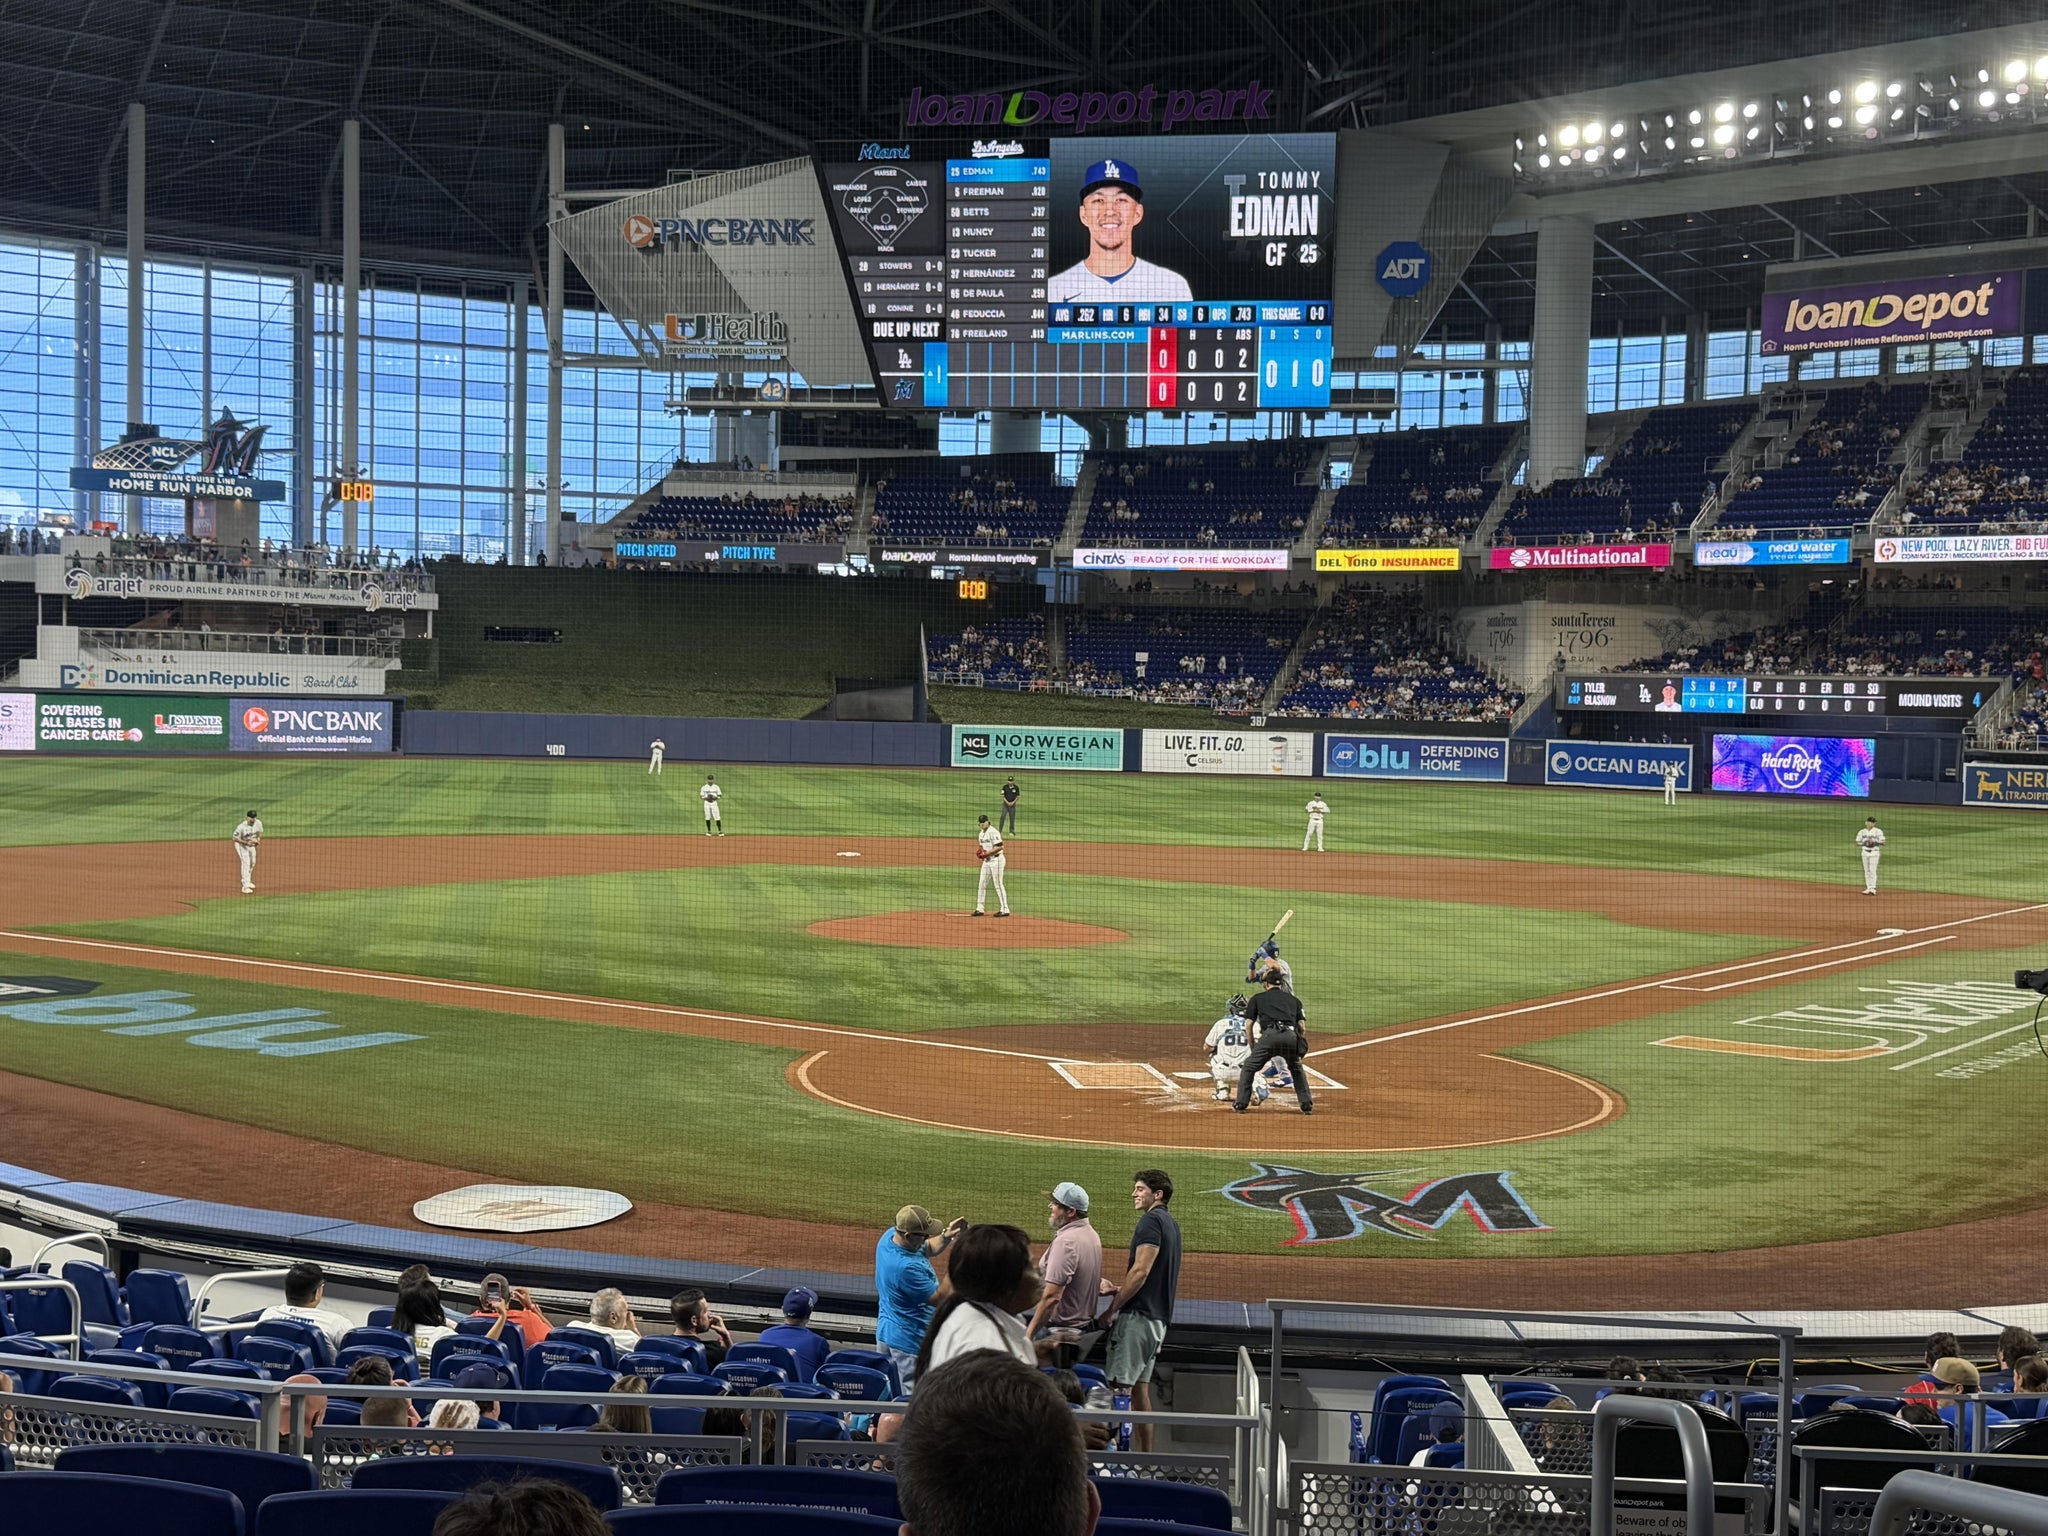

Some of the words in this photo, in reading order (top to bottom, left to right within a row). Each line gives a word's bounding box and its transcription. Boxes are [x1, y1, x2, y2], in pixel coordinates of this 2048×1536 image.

[907, 84, 1158, 133] loanDepot
[1162, 80, 1275, 131] park
[858, 143, 911, 161] Miami
[971, 140, 988, 154] Los
[986, 140, 1025, 159] Angeles
[963, 167, 993, 176] EDMAN
[1258, 171, 1320, 189] TOMMY
[963, 187, 1004, 196] FREEMAN
[963, 208, 990, 216] BETTS
[1230, 194, 1319, 237] EDMAN
[963, 227, 994, 236] MUNCY
[963, 249, 997, 258] TUCKER
[1265, 243, 1287, 266] CF
[1300, 243, 1318, 263] 25
[879, 262, 913, 270] STOWERS
[963, 268, 1016, 278] HERNÁNDEZ
[1382, 258, 1426, 280] ADT
[963, 289, 975, 298] DE
[976, 289, 1005, 298] PAULA
[887, 304, 914, 312] CONINE
[963, 310, 1005, 318] FEDUCCIA
[1055, 309, 1070, 322] AVG
[1123, 308, 1130, 321] 6
[1159, 308, 1169, 320] 34
[1198, 308, 1204, 321] 6
[1212, 308, 1227, 321] OPS
[1235, 307, 1251, 321] .743
[1262, 307, 1278, 321] THIS
[1279, 307, 1301, 321] GAME:
[1784, 282, 1995, 333] loanDepot
[873, 322, 895, 337] DUE
[896, 322, 911, 337] UP
[912, 322, 940, 337] NEXT
[963, 329, 1008, 338] FREELAND
[1062, 331, 1135, 340] MARLINS.COM
[1235, 329, 1251, 340] ABS
[1784, 342, 1808, 351] Home
[1809, 339, 1850, 350] Purchase
[1854, 336, 1880, 345] Home
[1881, 333, 1926, 344] Refinance
[1929, 328, 1993, 340] loanDepot.com
[665, 347, 701, 355] UNIVERSITY
[702, 347, 710, 355] OF
[711, 347, 733, 355] MIAMI
[734, 347, 758, 355] HEALTH
[759, 347, 784, 355] SYSTEM
[898, 348, 912, 369] LA
[1159, 349, 1168, 369] 0
[1188, 349, 1197, 370] 0
[1215, 349, 1224, 369] 0
[1238, 348, 1247, 368] 2
[1266, 360, 1278, 388] 0
[1292, 360, 1299, 388] 1
[1312, 359, 1324, 387] 0
[763, 382, 782, 397] 42
[1159, 382, 1168, 402] 0
[1187, 382, 1197, 402] 0
[1214, 382, 1223, 401] 0
[1238, 381, 1246, 401] 2
[151, 446, 178, 458] NCL
[129, 472, 184, 481] NORWEGIAN
[185, 475, 215, 483] CRUISE
[217, 477, 236, 485] LINE
[109, 478, 154, 492] HOME
[159, 481, 193, 494] RUN
[196, 483, 252, 497] HARBOR
[341, 482, 372, 502] 0:08
[616, 543, 644, 557] PITCH
[646, 543, 677, 558] SPEED
[723, 546, 750, 559] PITCH
[752, 547, 776, 560] TYPE
[1801, 542, 1838, 552] water
[1901, 540, 1922, 552] NEW
[1925, 540, 1951, 551] POOL.
[1954, 540, 1979, 551] LAZY
[2015, 539, 2031, 550] BIG
[881, 550, 937, 563] loanDepot
[949, 553, 969, 562] Home
[996, 554, 1037, 565] Everything
[1133, 556, 1169, 564] READY
[1173, 556, 1194, 564] FOR
[1199, 556, 1219, 564] THE
[1222, 556, 1276, 565] WORKDAY
[1320, 558, 1342, 567] DEL
[1344, 554, 1378, 567] TORO
[1382, 557, 1455, 567] INSURANCE
[1533, 547, 1647, 566] Multinational
[95, 574, 144, 599] arajet
[150, 584, 182, 593] PROUD
[186, 587, 223, 595] AIRLINE
[226, 588, 268, 597] PARTNER
[284, 591, 300, 599] THE
[383, 589, 418, 612] arajet
[960, 580, 986, 600] 0:08
[1488, 628, 1514, 652] 1796
[1558, 628, 1609, 653] 1796
[105, 669, 207, 686] Dominican
[211, 671, 290, 689] Republic
[303, 675, 334, 688] Beach
[336, 676, 358, 687] Club
[1584, 683, 1605, 693] TYLER
[1639, 684, 1651, 703] LA
[1821, 683, 1832, 693] ER
[1867, 683, 1879, 694] SO
[1899, 693, 1932, 707] MOUND
[1933, 694, 1963, 708] VISITS
[1972, 692, 1982, 707] 4
[1584, 695, 1617, 706] GLASNOW
[1750, 698, 1764, 709] 0.0
[41, 705, 102, 716] COVERING
[41, 717, 64, 728] ALL
[66, 717, 105, 728] BASES
[108, 718, 121, 729] IN
[1250, 716, 1267, 726] 387
[41, 729, 89, 740] CANCER
[92, 730, 125, 741] CARE
[257, 735, 285, 743] Official
[286, 735, 306, 743] Bank
[306, 735, 314, 743] of
[315, 735, 327, 743] the
[328, 735, 349, 743] Miami
[963, 737, 989, 749] NCL
[995, 735, 1114, 750] NORWEGIAN
[1165, 735, 1197, 750] LIVE.
[1200, 736, 1222, 751] FIT.
[1225, 737, 1245, 752] GO.
[546, 744, 565, 756] 400
[995, 751, 1047, 760] CRUISE
[1052, 752, 1084, 762] LINE
[1335, 751, 1353, 760] ADT
[1360, 744, 1410, 770] blu
[1421, 745, 1499, 759] DEFENDING
[1421, 759, 1461, 771] HOME
[1575, 756, 1633, 774] OCEAN
[1761, 752, 1792, 768] Hard
[1792, 754, 1821, 773] Rock
[1783, 773, 1799, 781] BET
[1616, 1515, 1656, 1527] Beware
[1659, 1515, 1669, 1527] of
